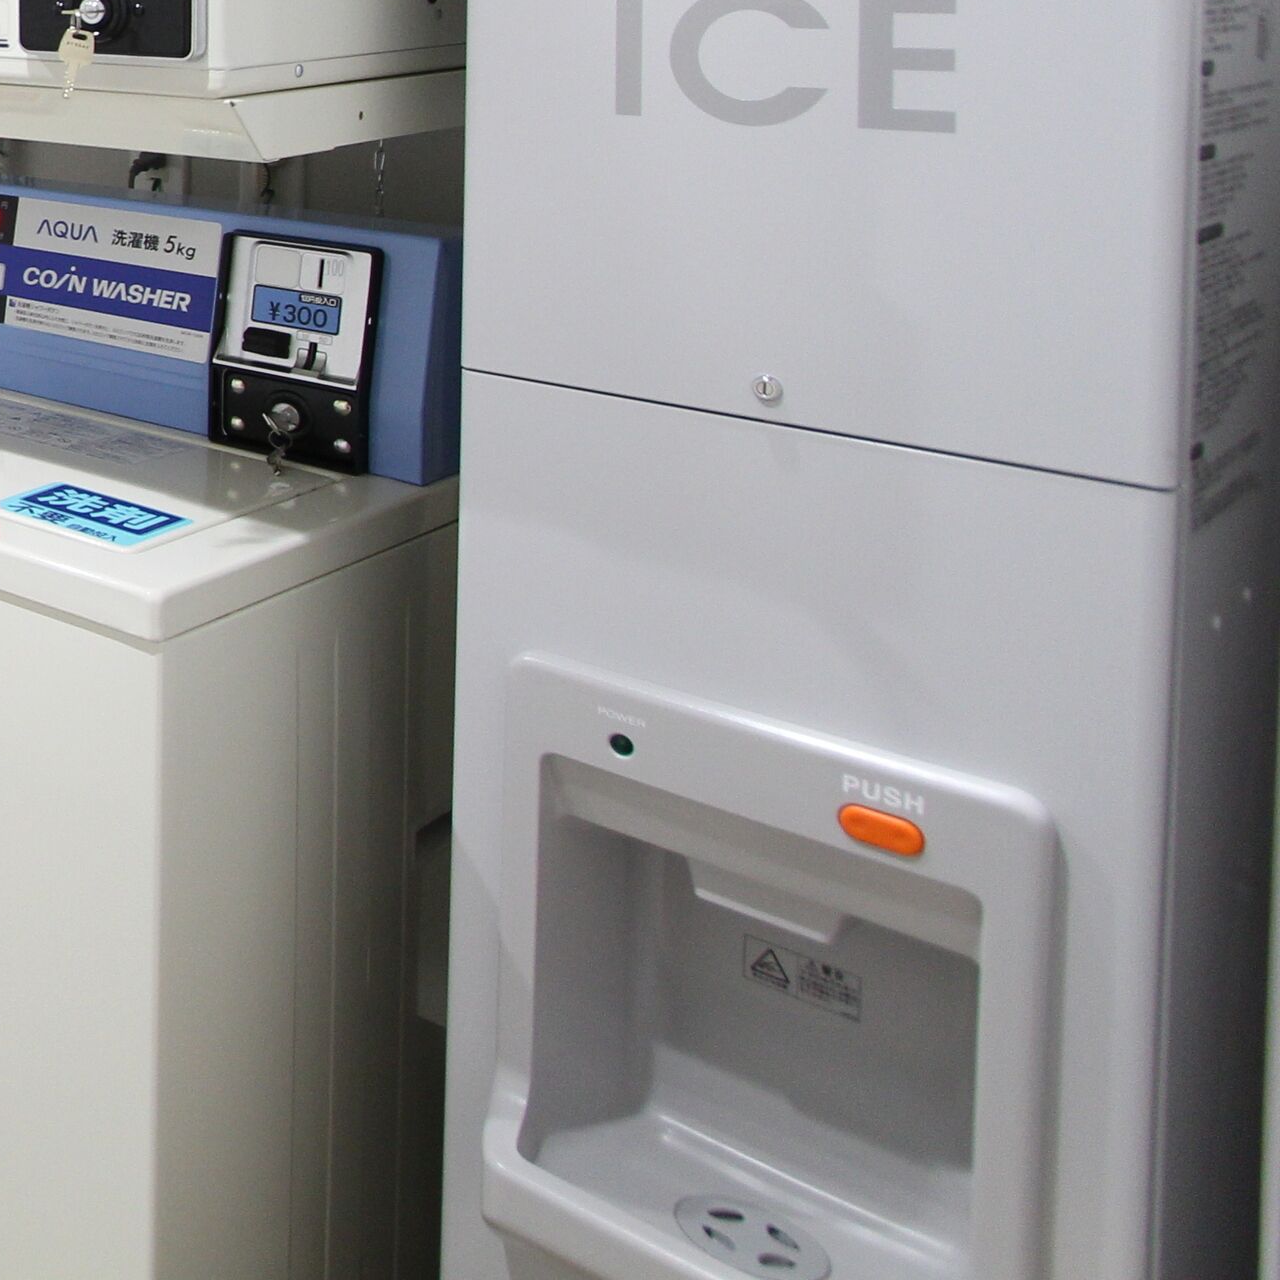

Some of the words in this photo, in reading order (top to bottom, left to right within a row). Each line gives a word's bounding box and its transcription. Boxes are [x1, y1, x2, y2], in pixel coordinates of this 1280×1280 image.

[37, 219, 98, 243] AQUA
[111, 228, 159, 251] 洗濯機
[163, 235, 196, 260] 5kg
[92, 278, 191, 313] WASHER
[268, 301, 328, 328] ¥300
[7, 501, 74, 525] 不要
[37, 488, 170, 531] 洗剤
[597, 705, 646, 729] POWER
[842, 773, 925, 816] PUSH
